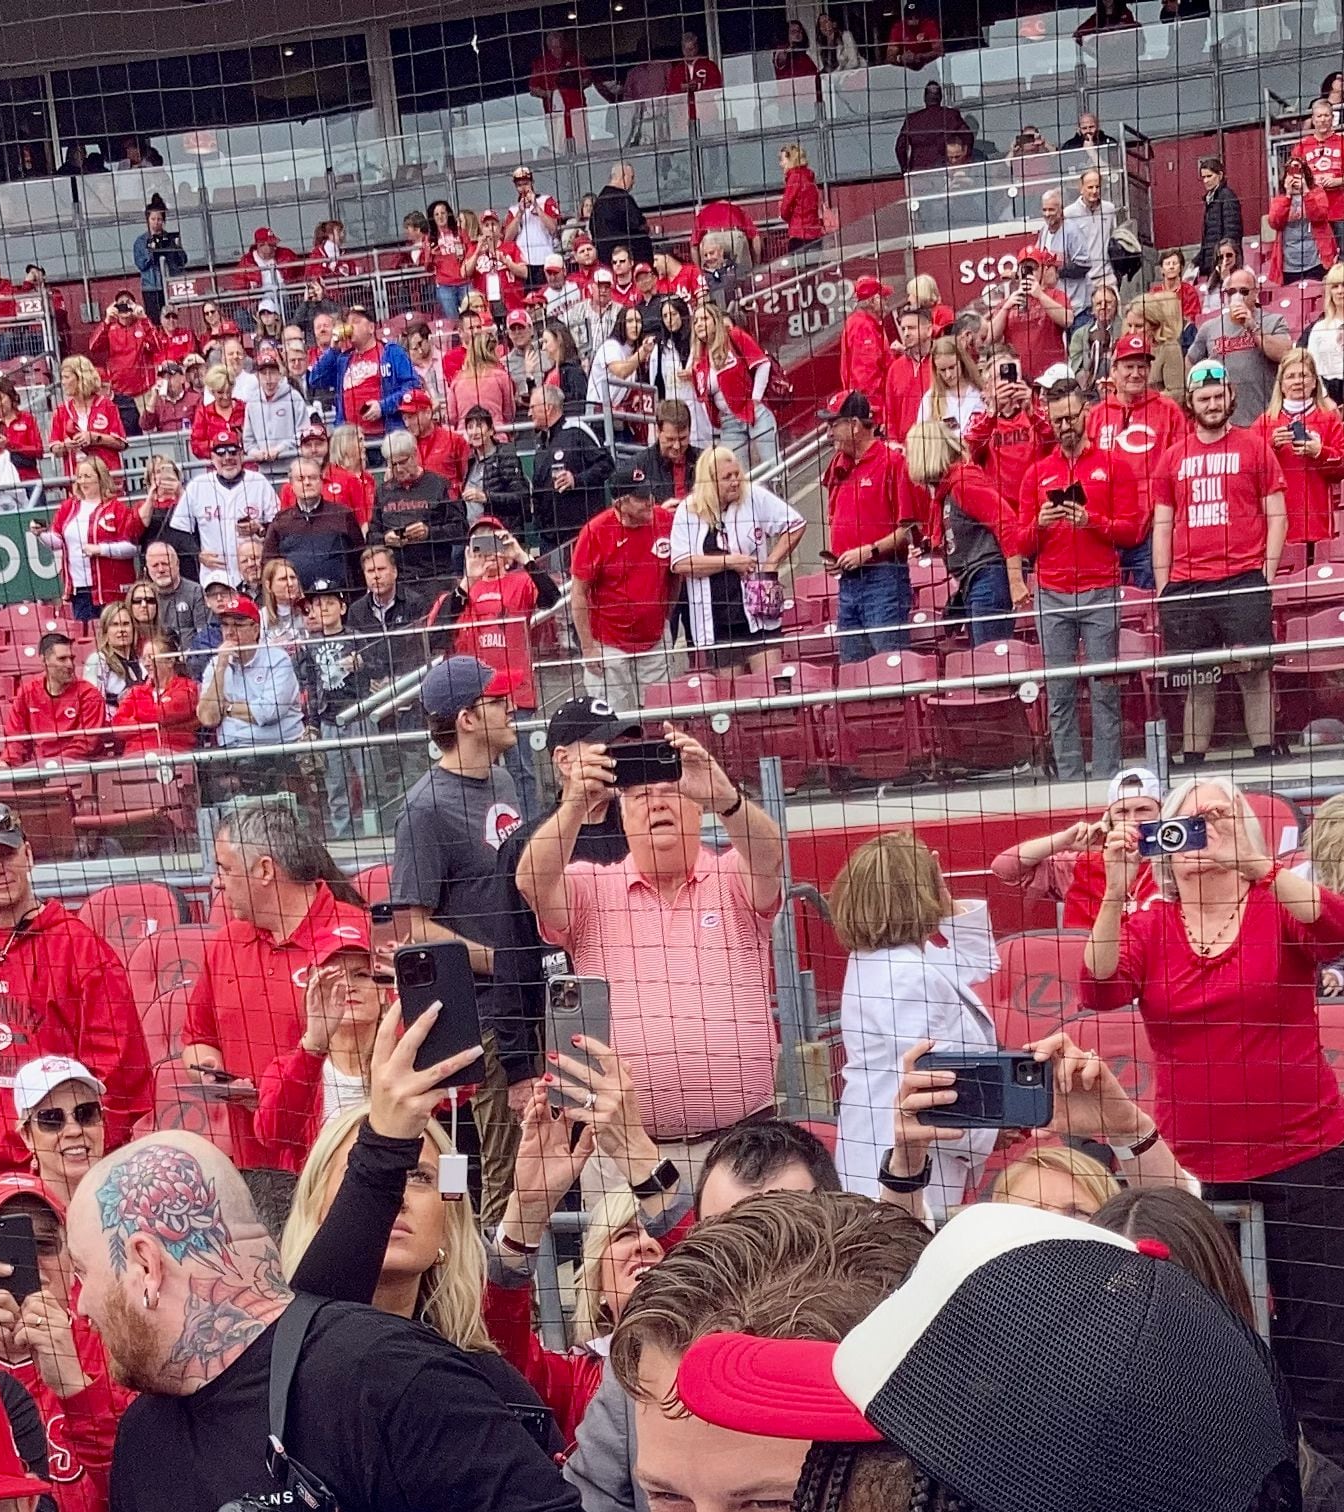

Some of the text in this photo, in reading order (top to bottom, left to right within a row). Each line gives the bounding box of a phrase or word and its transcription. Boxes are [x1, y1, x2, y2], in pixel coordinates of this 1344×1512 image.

[172, 283, 196, 297] 122
[19, 300, 43, 313] 123
[1205, 453, 1240, 476] VOTTO
[1192, 477, 1223, 503] STILL
[204, 506, 221, 521] 54
[1188, 502, 1228, 528] BANGS
